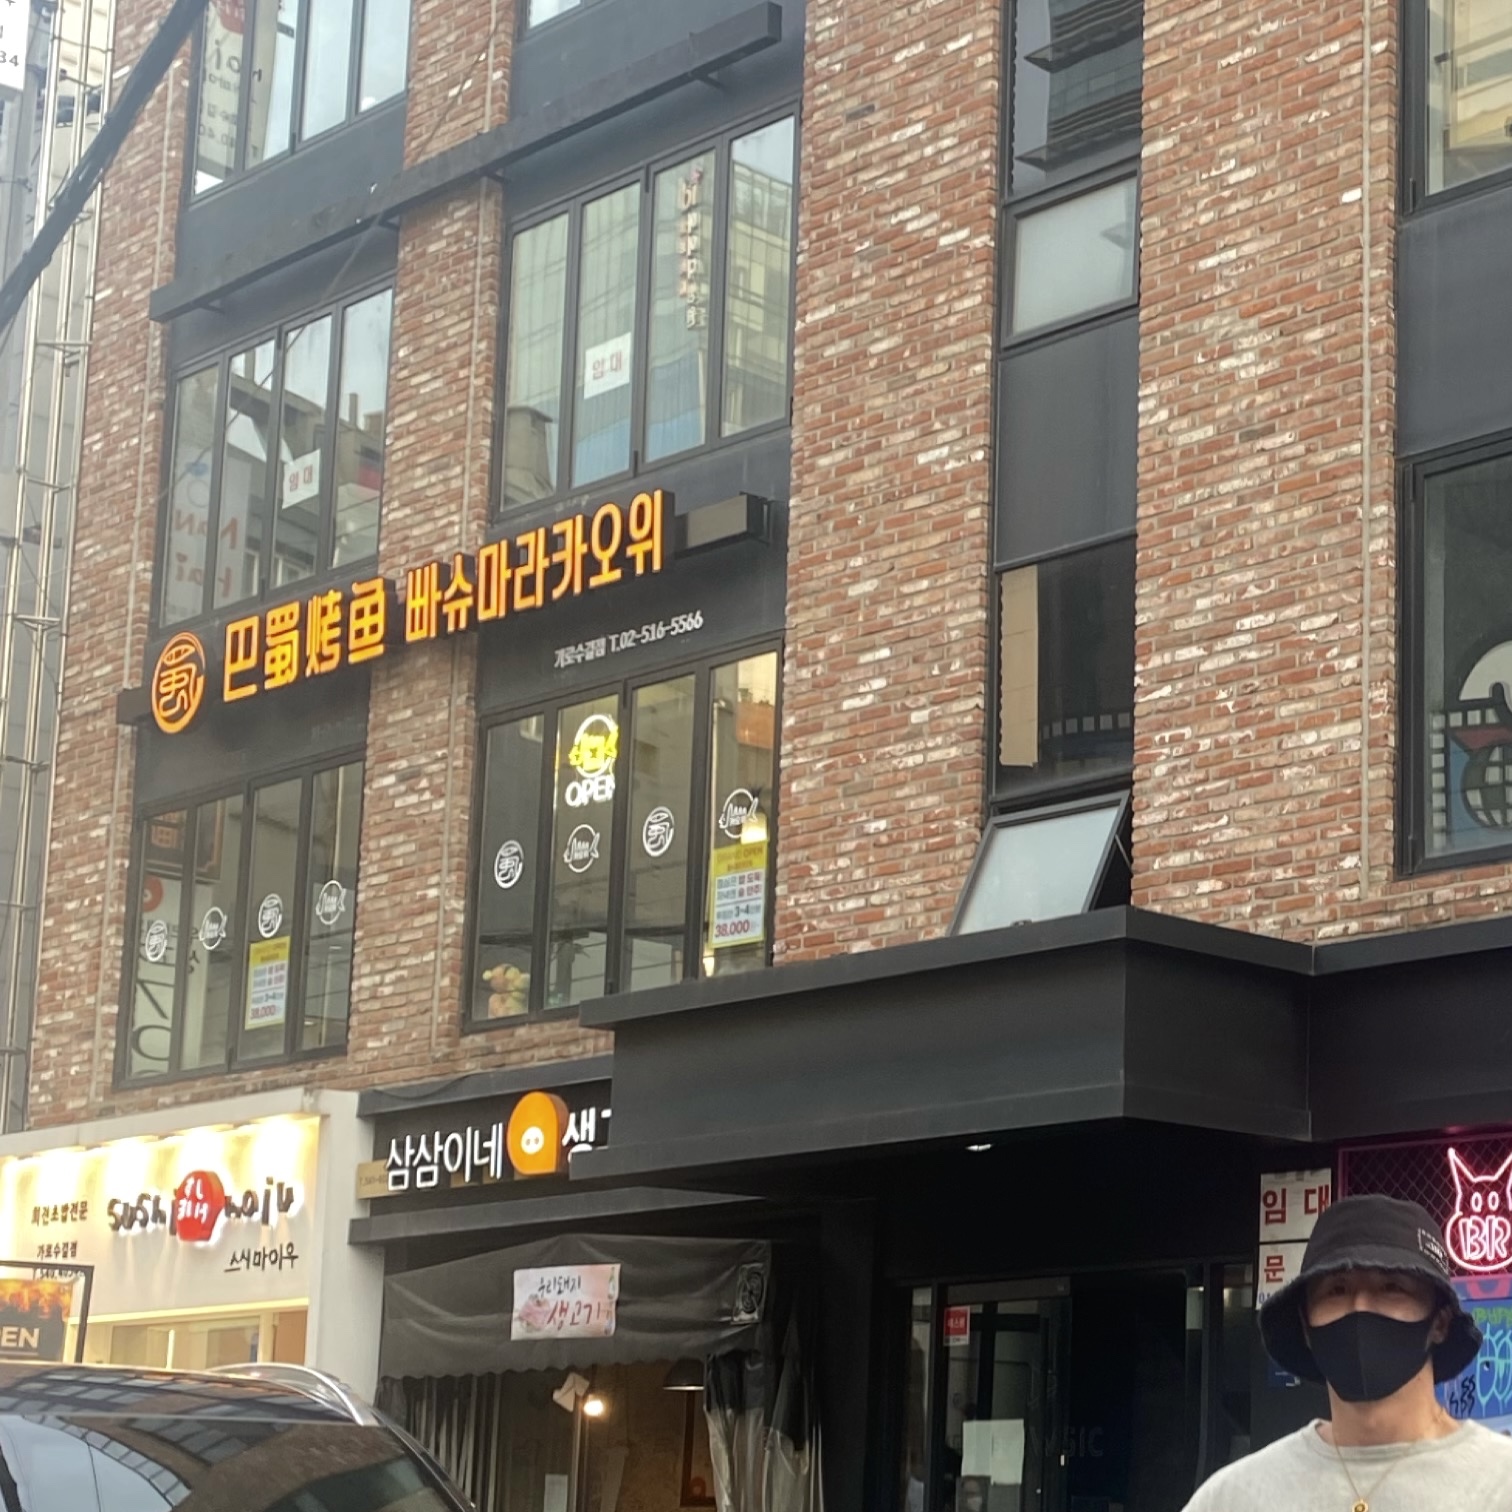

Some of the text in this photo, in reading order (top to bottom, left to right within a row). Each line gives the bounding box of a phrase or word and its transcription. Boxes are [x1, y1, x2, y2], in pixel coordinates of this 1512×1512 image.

[406, 489, 663, 643] 빠슈마라카오위
[385, 1121, 504, 1192] 삼삼이네
[1459, 1215, 1511, 1260] BR
